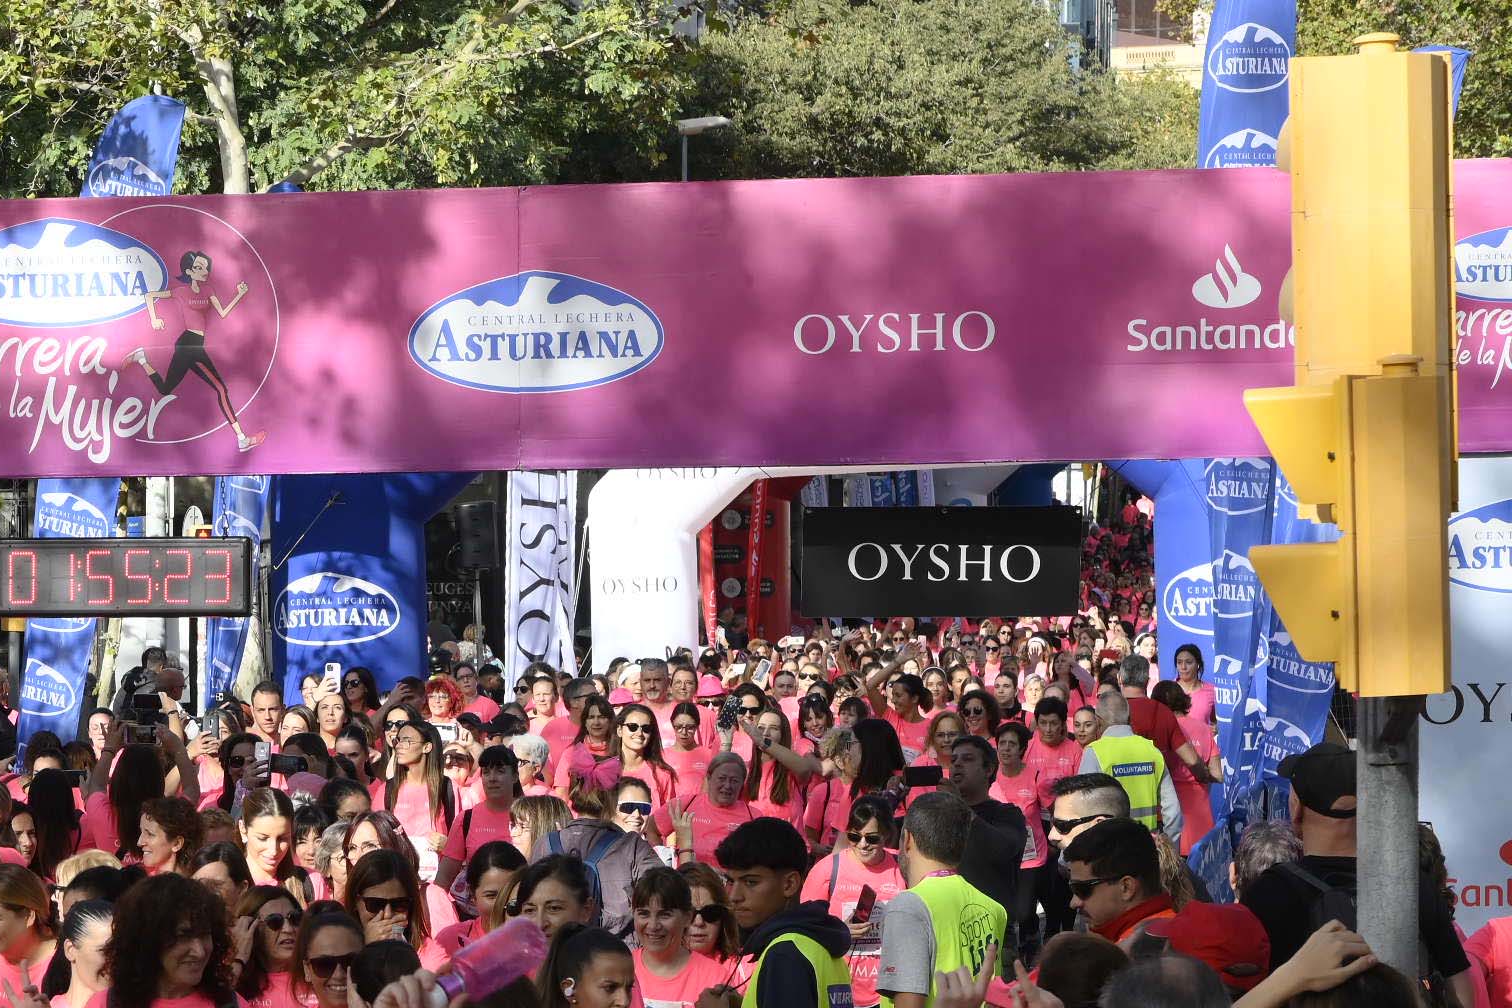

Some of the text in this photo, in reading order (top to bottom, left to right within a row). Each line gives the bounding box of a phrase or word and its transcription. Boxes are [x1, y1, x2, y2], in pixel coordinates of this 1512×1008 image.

[1216, 50, 1287, 76] ASTURIANA
[467, 311, 636, 327] CENTRAL LECHERA
[793, 310, 997, 354] OYSHO
[427, 318, 644, 362] ASTURIANA
[8, 379, 33, 419] la
[28, 371, 177, 463] Mujer
[8, 549, 232, 605] 01:55:23
[846, 542, 1041, 583] OYSHO
[602, 576, 679, 595] OYSHO
[278, 602, 391, 629] ASTURIANA
[290, 597, 386, 606] CENTRAL LECHERA
[1113, 765, 1153, 775] VOLUNTARIS
[960, 912, 994, 948] Sport
